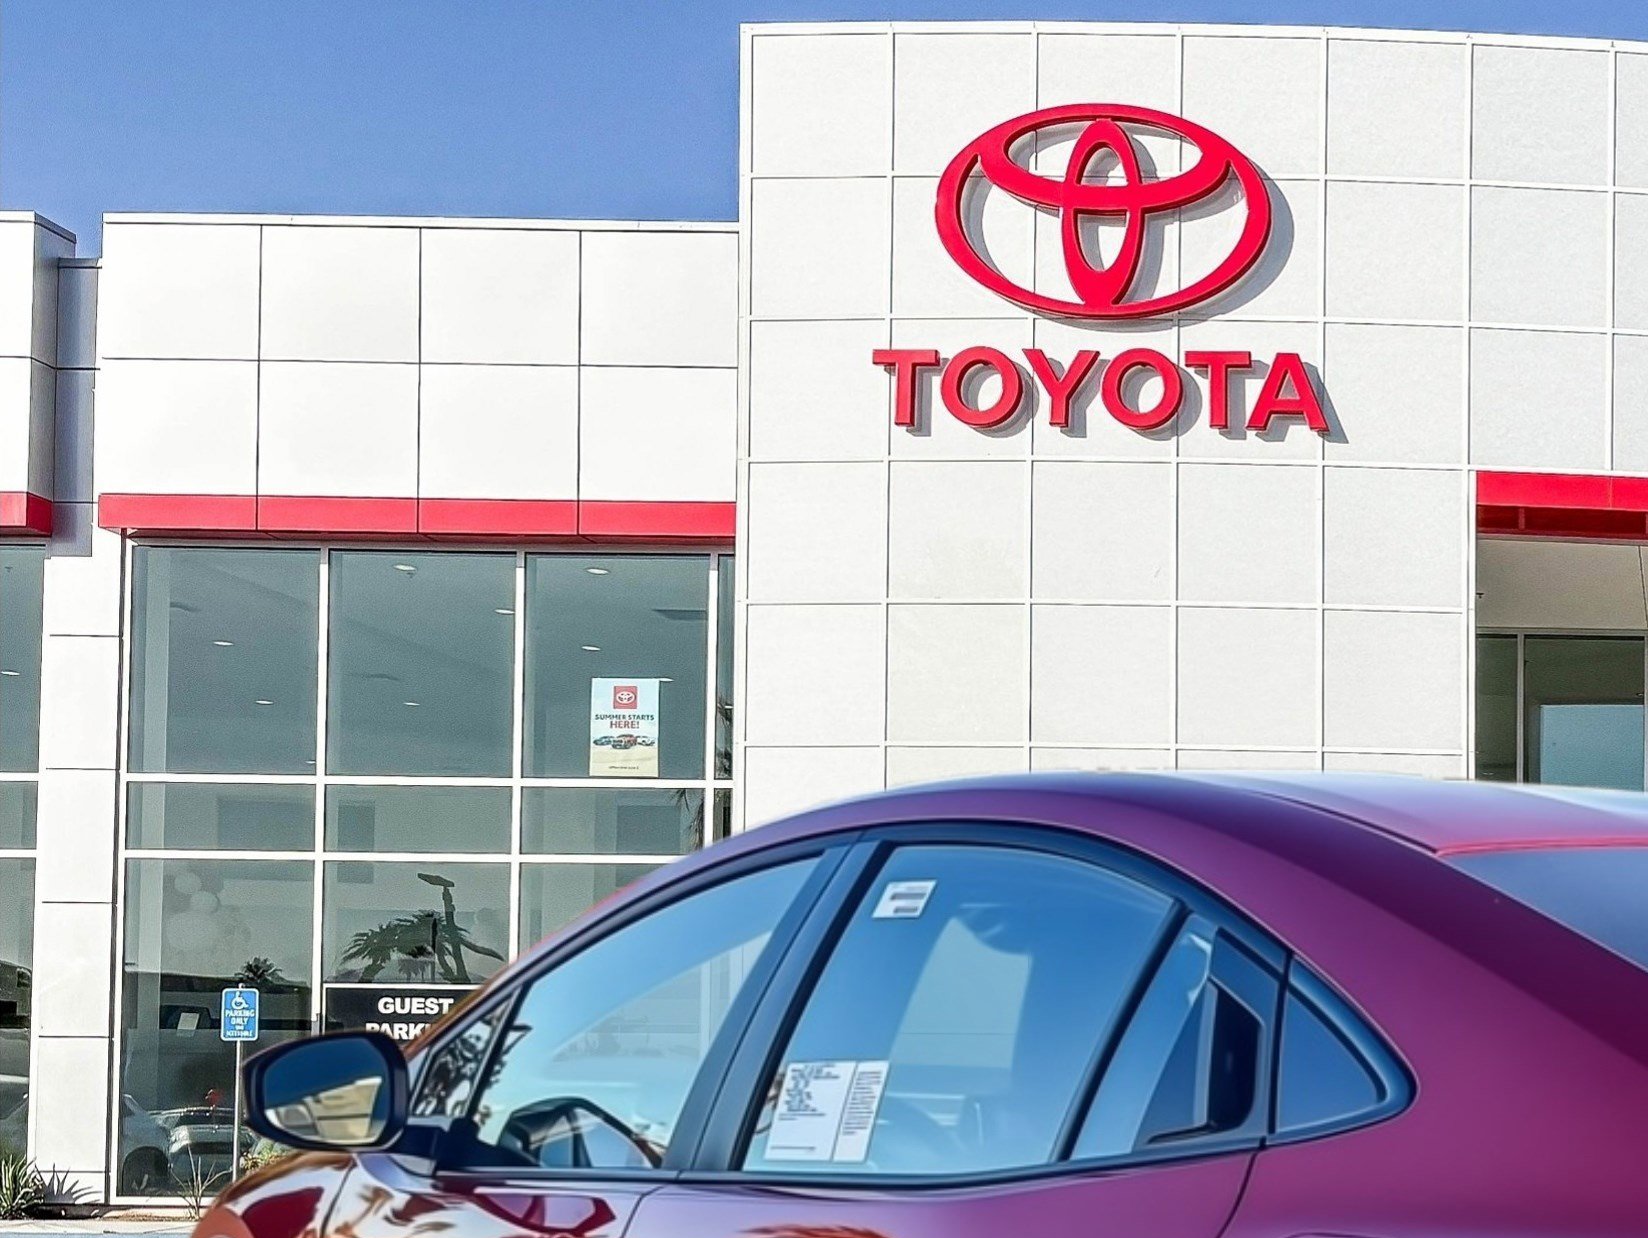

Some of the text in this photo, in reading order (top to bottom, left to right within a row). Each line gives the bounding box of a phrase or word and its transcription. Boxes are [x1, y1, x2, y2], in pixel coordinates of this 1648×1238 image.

[873, 346, 1329, 434] TOYOTA
[609, 721, 640, 730] HERE!
[377, 997, 455, 1015] GUEST
